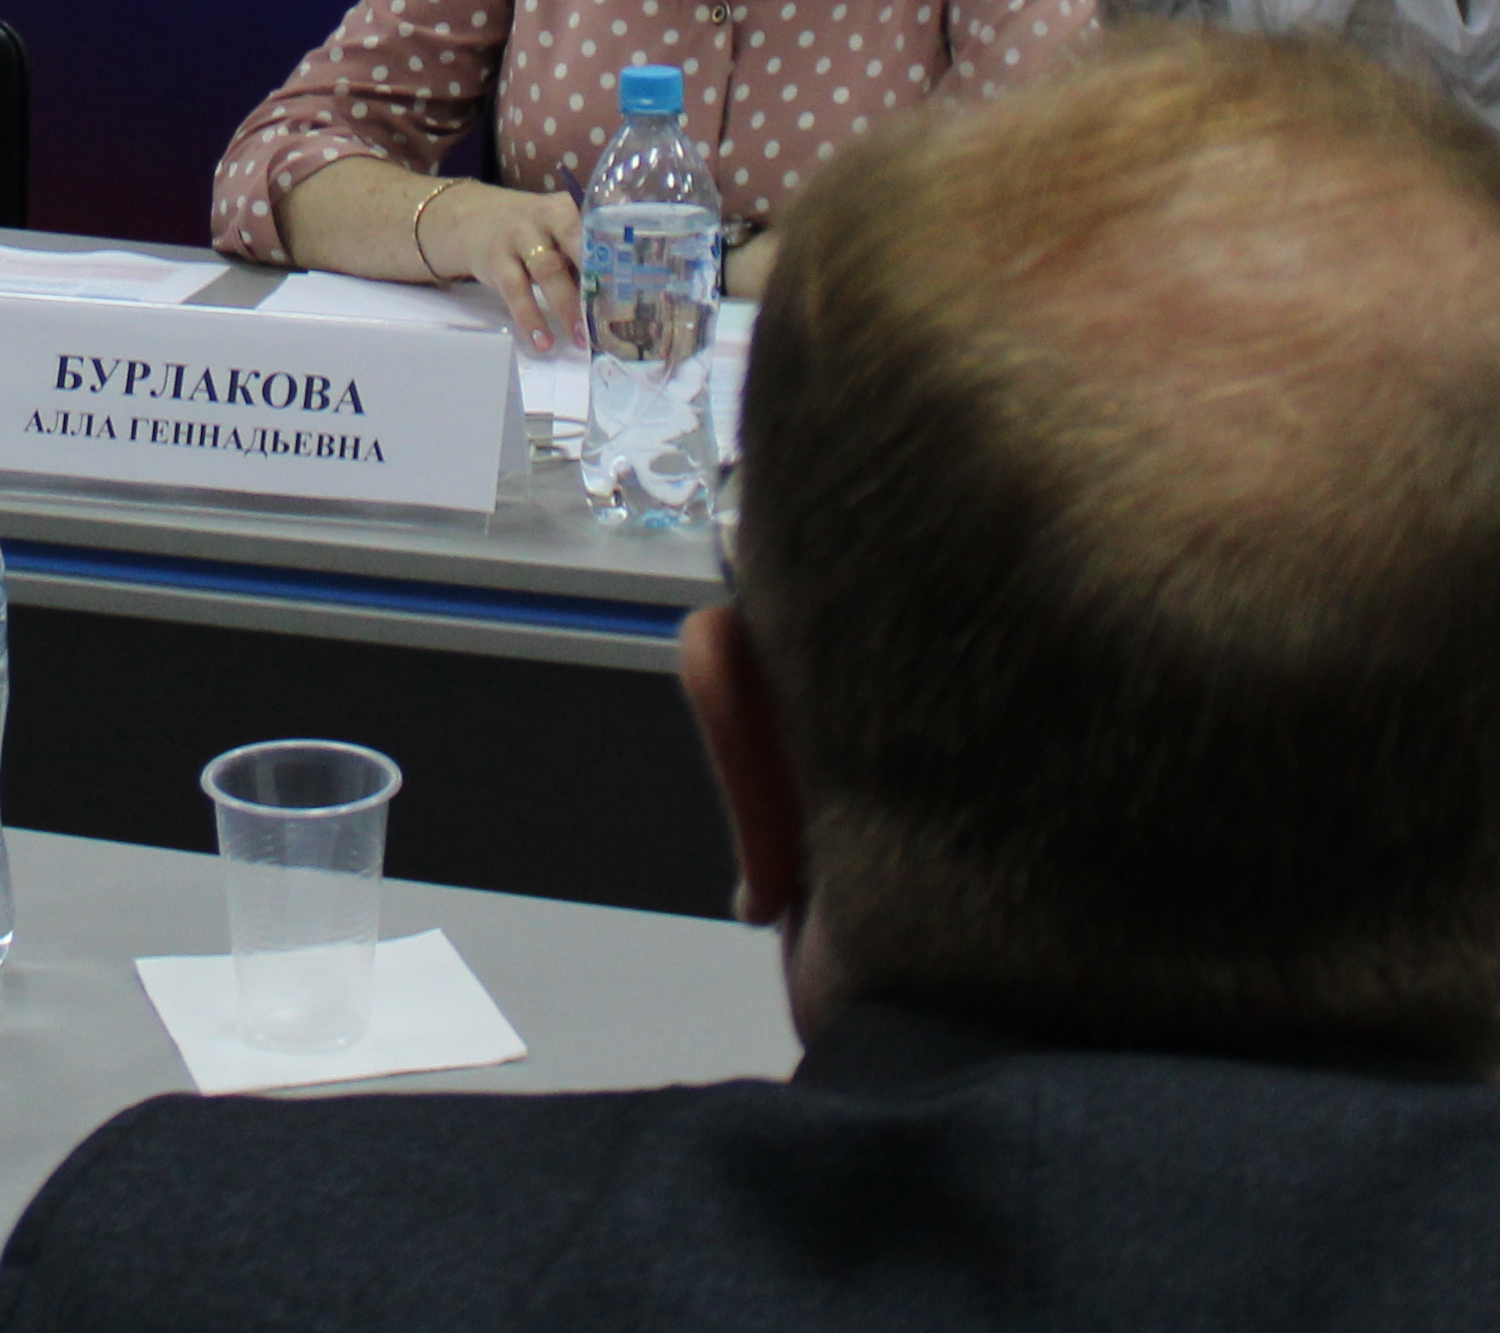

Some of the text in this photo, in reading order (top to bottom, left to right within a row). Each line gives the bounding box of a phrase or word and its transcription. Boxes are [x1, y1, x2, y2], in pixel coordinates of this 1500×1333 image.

[54, 353, 367, 416] БУРЛАКОВА
[23, 408, 387, 465] АЛЛА ГЕННАДЬЕВНА
